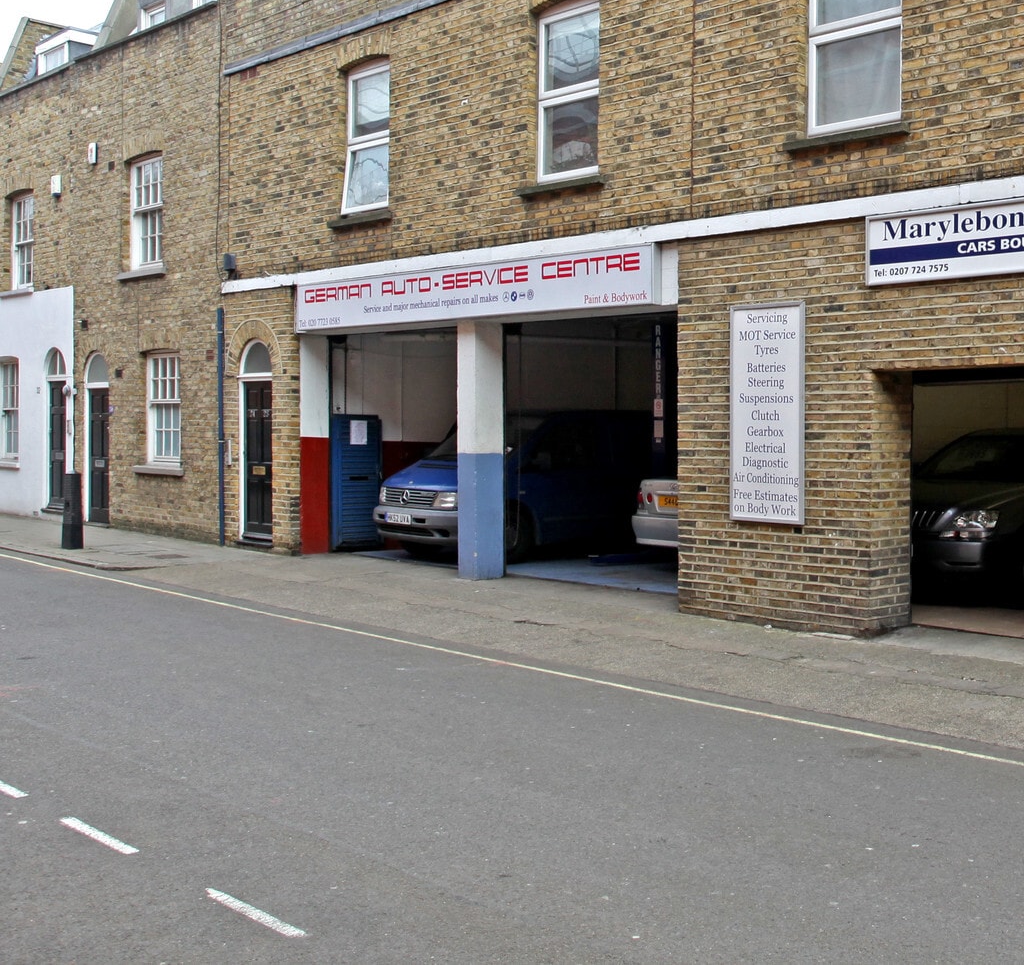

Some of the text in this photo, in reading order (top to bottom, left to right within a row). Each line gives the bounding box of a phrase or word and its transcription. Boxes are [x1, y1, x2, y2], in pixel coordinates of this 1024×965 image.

[957, 239, 996, 254] CARS
[874, 263, 949, 277] Tel: 0207 724 7575
[304, 283, 372, 304] GERMAN
[541, 252, 640, 280] CENTRE
[363, 304, 381, 314] Service
[382, 302, 393, 312] and
[393, 300, 409, 313] major
[409, 297, 441, 310] mechanical
[441, 297, 461, 310] repairs
[470, 294, 479, 304] all
[480, 293, 499, 303] makes
[584, 290, 648, 304] Paint & Bodywork
[746, 312, 788, 325] Servicing
[739, 328, 796, 342] MOT Service
[754, 344, 779, 357] Tyres
[747, 361, 786, 373] Batteries
[748, 376, 785, 389] Steering
[739, 392, 794, 406] Suspensions
[751, 409, 780, 421] Clutch
[746, 425, 784, 437] Gearbox
[745, 441, 786, 454] Electrical
[742, 456, 789, 470] Diagnostic
[733, 472, 799, 488] Air Conditioning
[733, 488, 798, 503] Free Estimates
[734, 502, 796, 516] on Body Work
